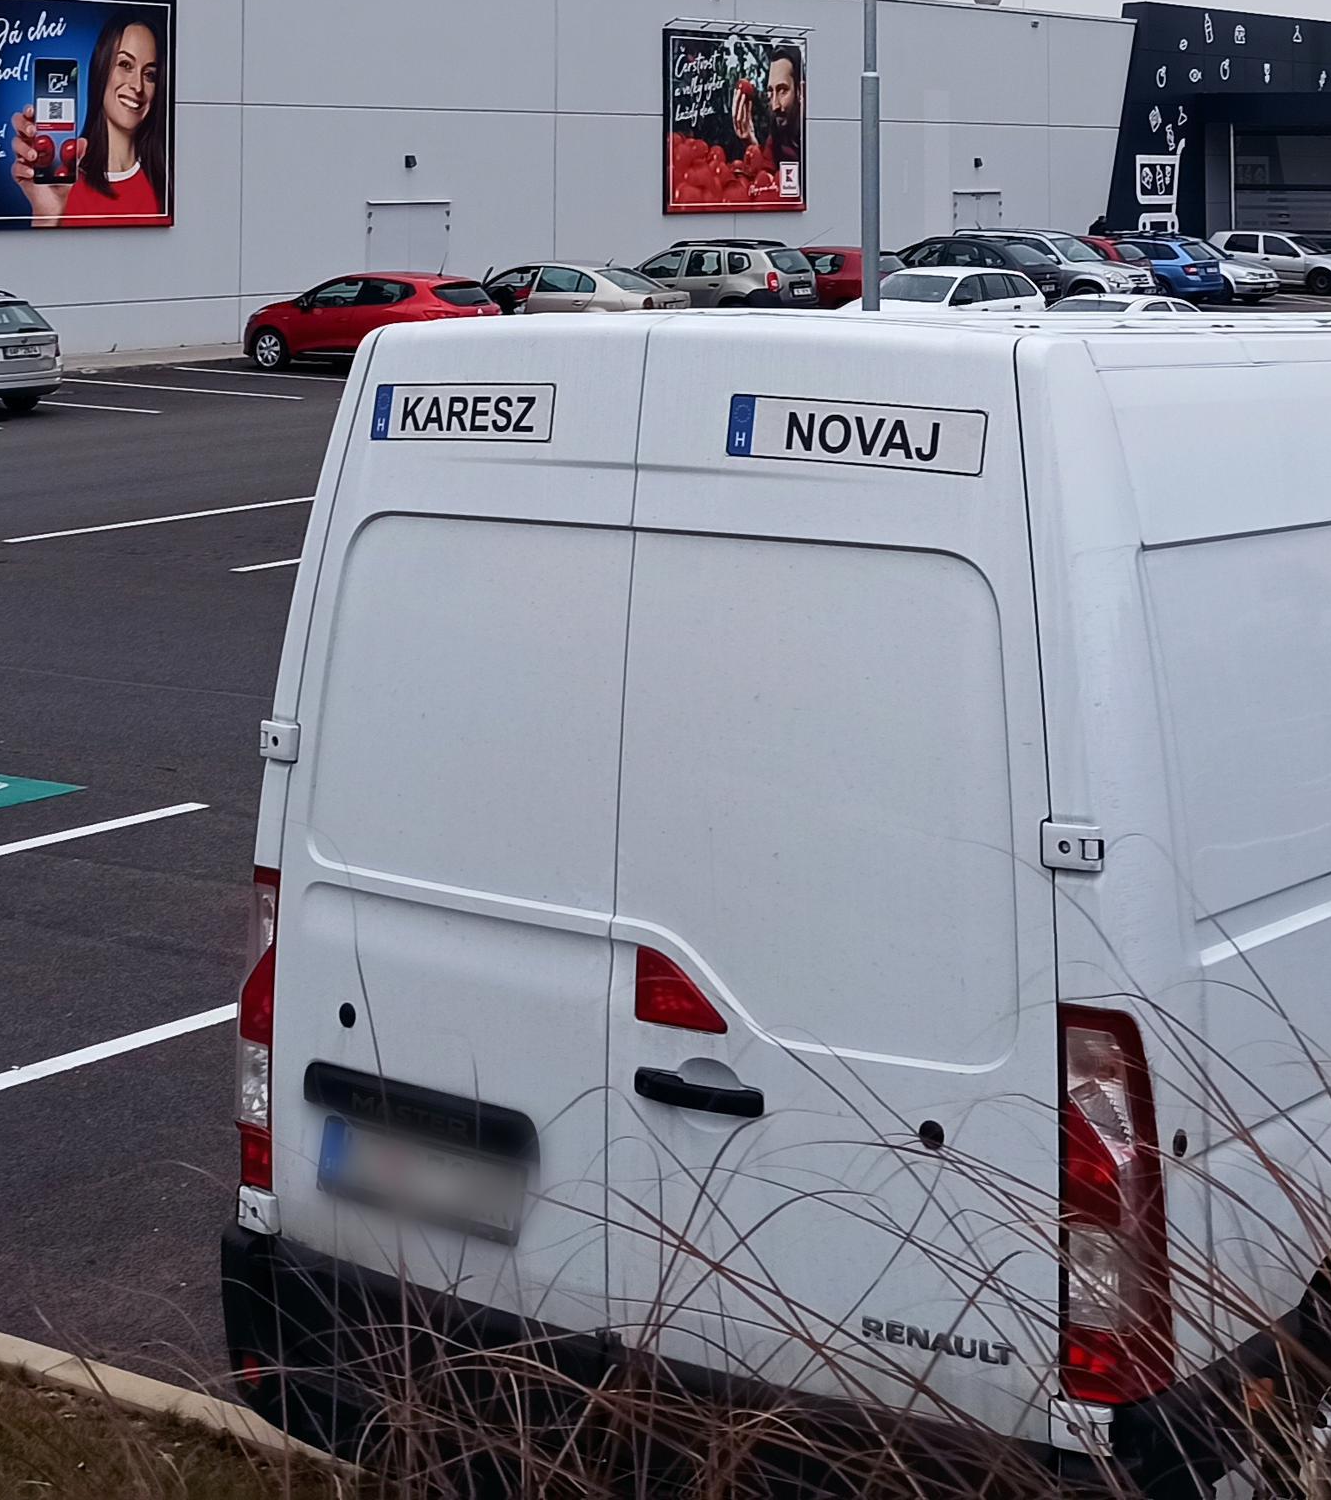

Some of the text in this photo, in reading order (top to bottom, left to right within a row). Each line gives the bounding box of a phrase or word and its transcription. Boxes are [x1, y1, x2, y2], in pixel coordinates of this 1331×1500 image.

[28, 11, 66, 41] chci
[377, 396, 536, 432] H KARESZ
[735, 411, 941, 462] H NOVAJ
[351, 1092, 468, 1140] MASTER
[862, 1315, 1012, 1366] RENAULT
